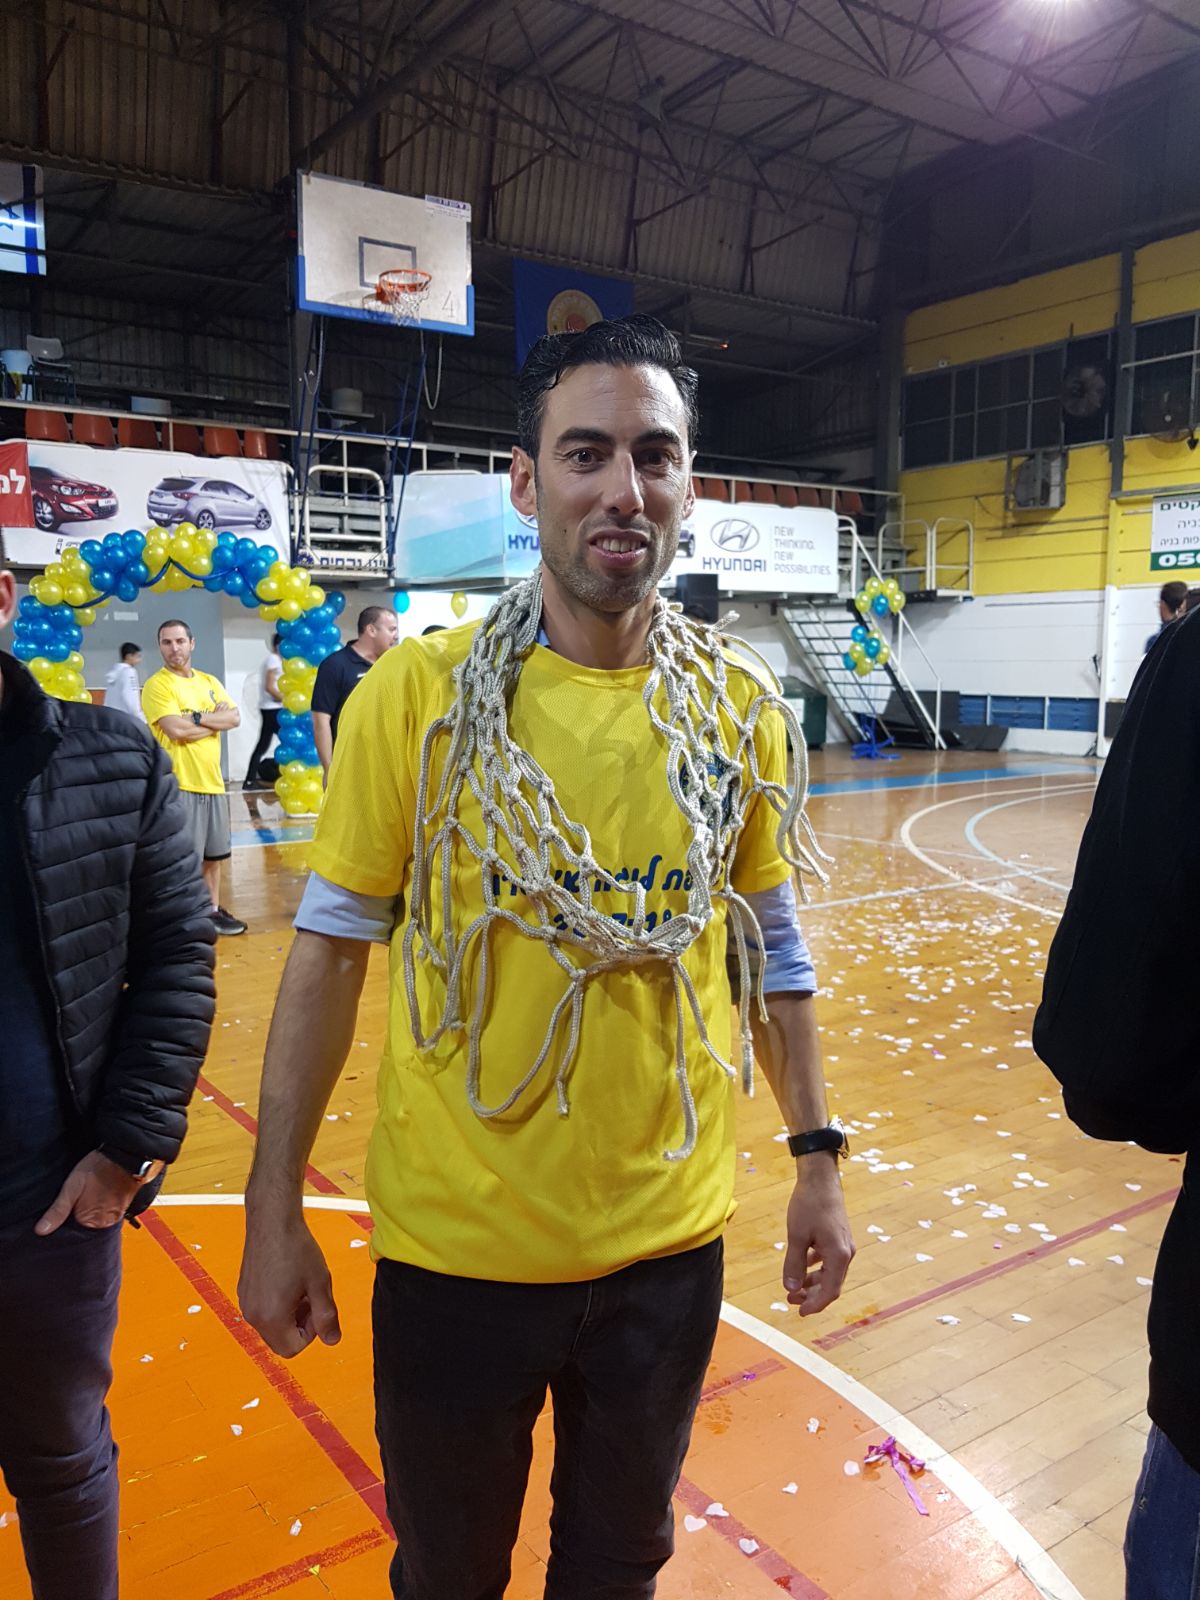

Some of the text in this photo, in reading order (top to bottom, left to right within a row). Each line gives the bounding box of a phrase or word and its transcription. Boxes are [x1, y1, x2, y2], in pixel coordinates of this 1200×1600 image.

[774, 526, 795, 537] NEW
[774, 550, 794, 561] NEW
[702, 556, 767, 573] HYUNDAI
